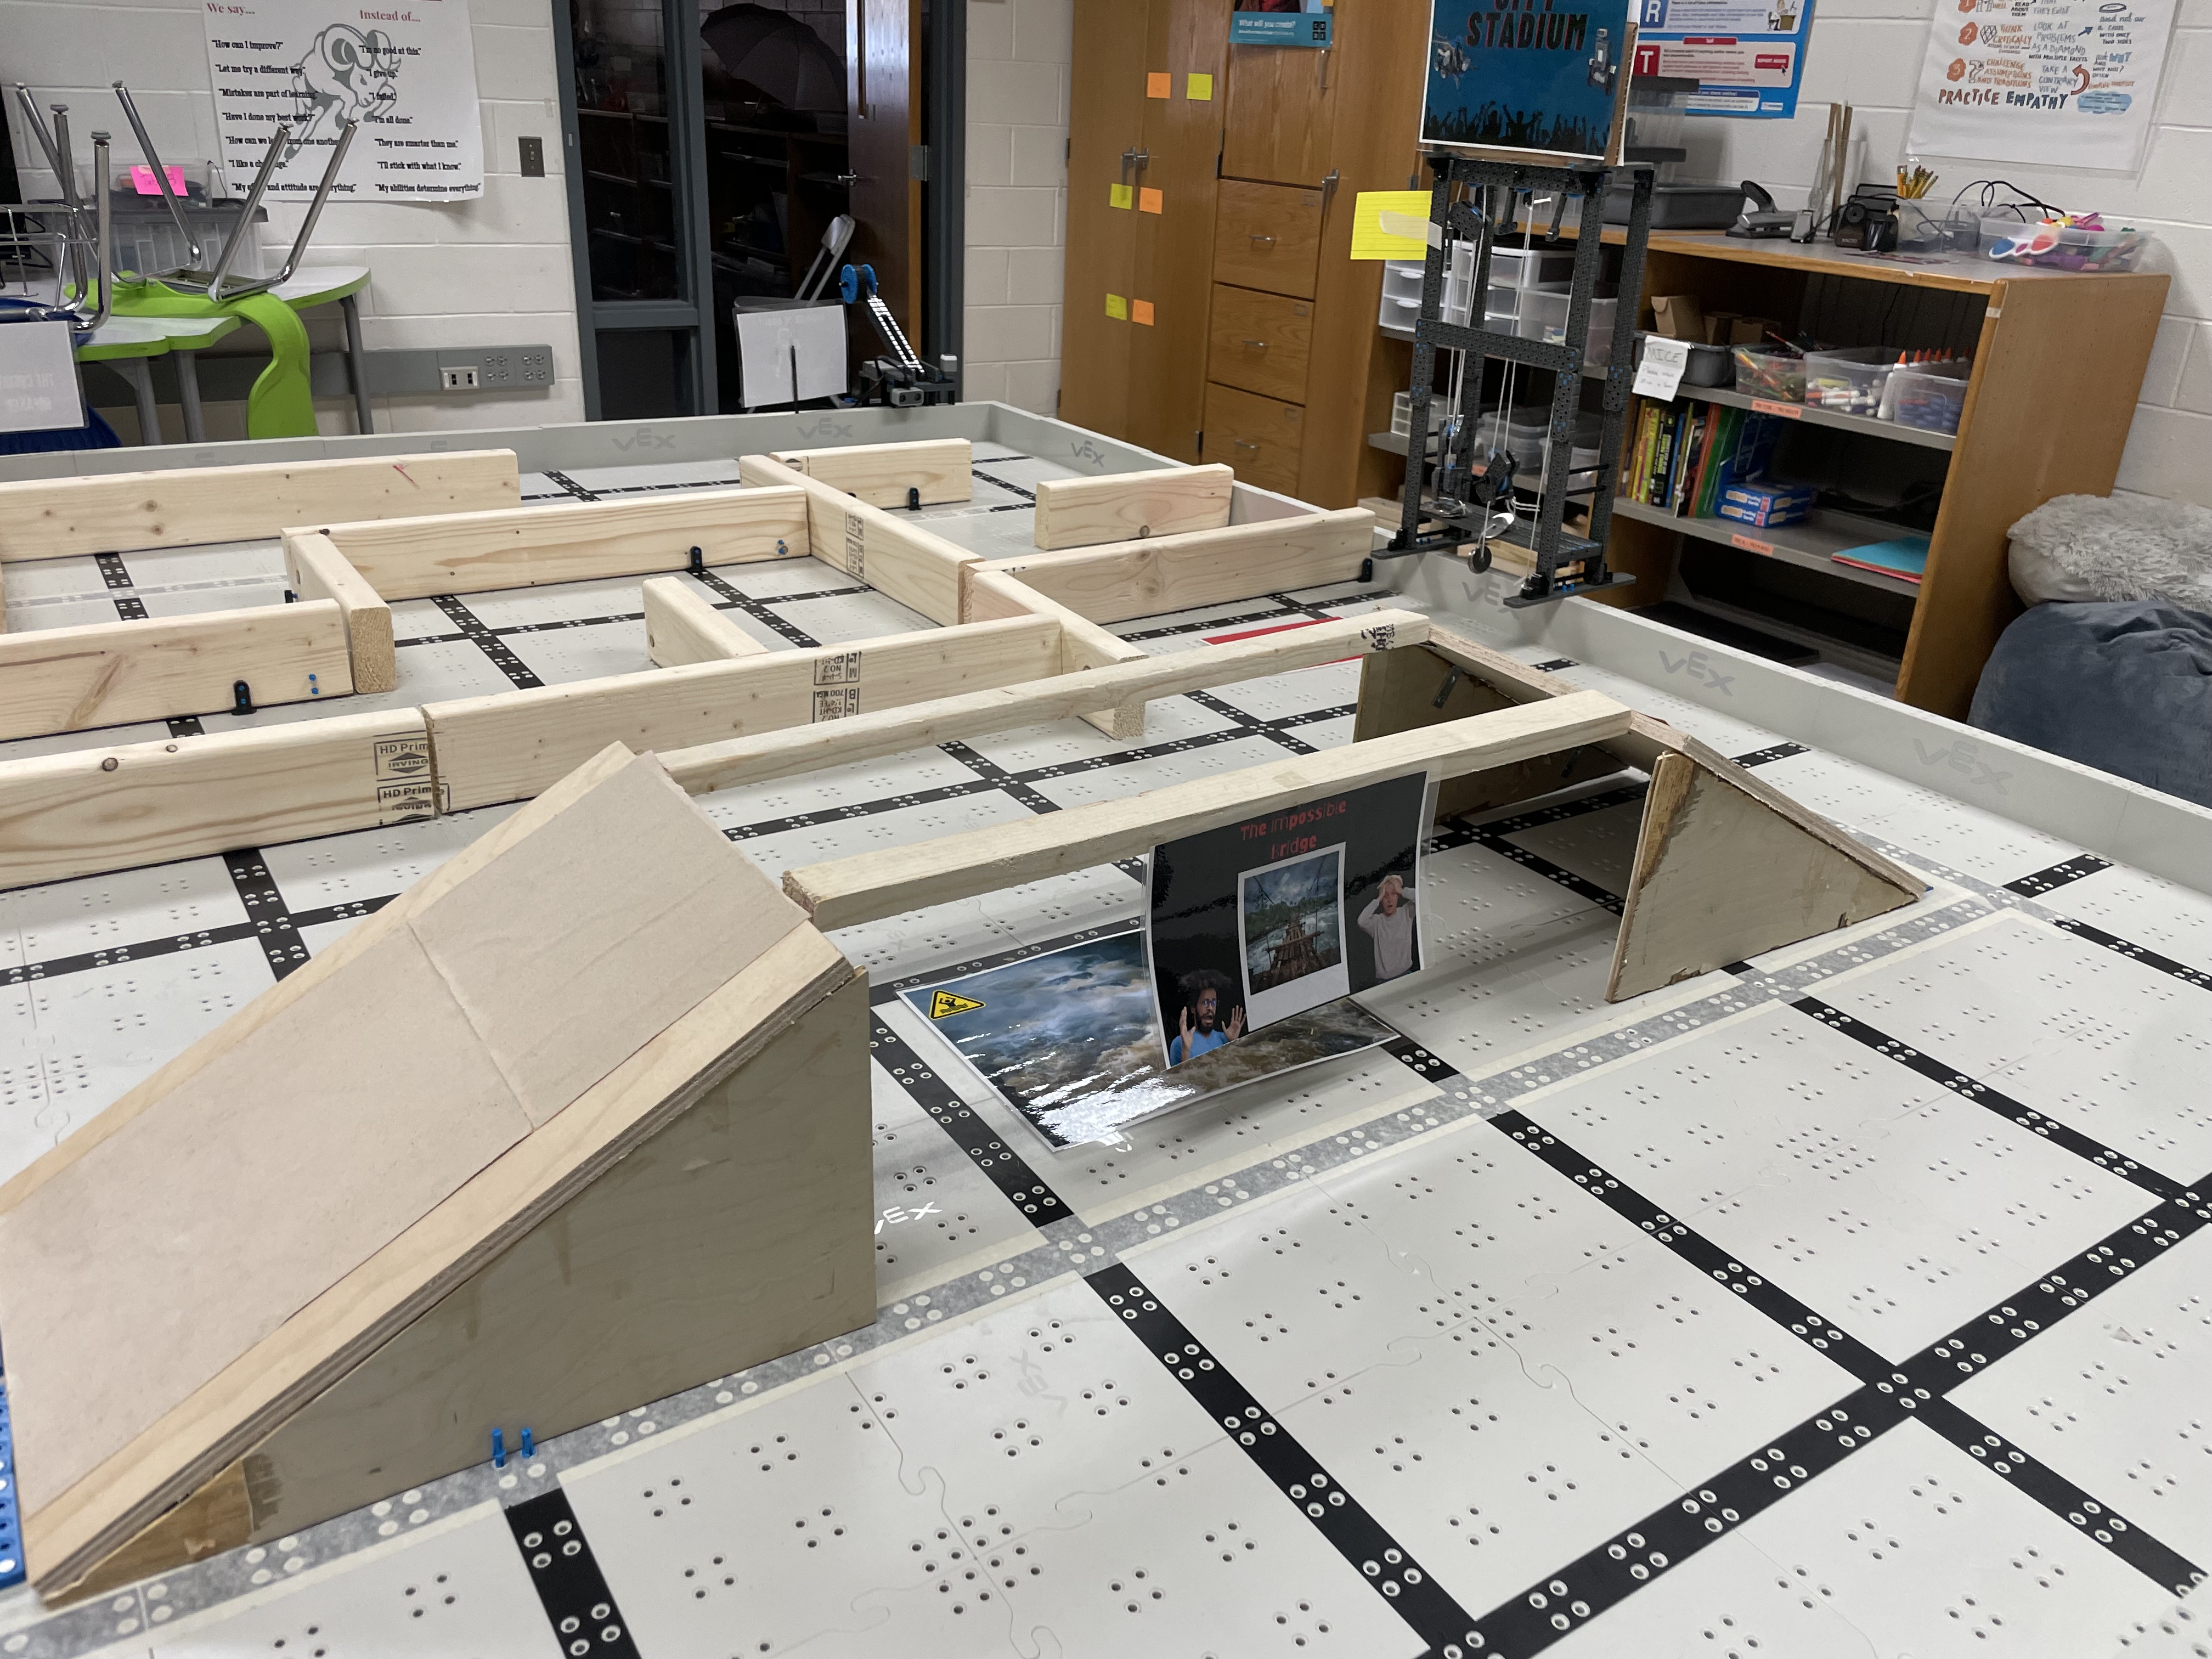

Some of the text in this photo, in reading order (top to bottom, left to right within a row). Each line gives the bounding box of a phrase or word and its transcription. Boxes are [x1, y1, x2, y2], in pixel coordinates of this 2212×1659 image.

[207, 3, 255, 16] We say...
[1645, 0, 1661, 22] R
[360, 10, 398, 21] Instead
[1466, 12, 1588, 51] STADIUM
[2000, 24, 2023, 33] THINK
[2033, 21, 2069, 31] LOOK AT
[1964, 28, 1972, 40] 2
[2037, 32, 2076, 43] PROBLEMS
[1993, 35, 2033, 45] CRITICALLY
[383, 46, 397, 55] good
[2032, 43, 2040, 53] AS
[2050, 44, 2085, 55] DIAMOND
[1640, 50, 1654, 73] T
[1987, 59, 2025, 70] CHALLENGE
[242, 65, 252, 75] try
[259, 65, 288, 74] different
[374, 70, 387, 78] give
[1984, 69, 2032, 79] ASSUMPTIONS
[2042, 65, 2059, 75] TAKE
[1994, 77, 2032, 88] TRADITIONS
[2039, 76, 2078, 88] CONTRARY
[266, 90, 279, 99] part
[1938, 88, 2001, 105] PRACTICE
[2006, 91, 2069, 109] EMPATHY
[249, 112, 264, 121] done
[266, 114, 275, 122] my
[278, 113, 291, 121] best
[1646, 347, 1683, 363] MICE
[796, 418, 853, 439] VEX
[611, 427, 677, 452] VEX
[1071, 439, 1105, 468] VEX
[1659, 650, 1735, 697] VEX
[380, 744, 397, 754] HD
[388, 759, 428, 768] IRVING
[1913, 738, 2013, 795] VEX
[383, 789, 400, 799] HD
[1240, 822, 1267, 840] The
